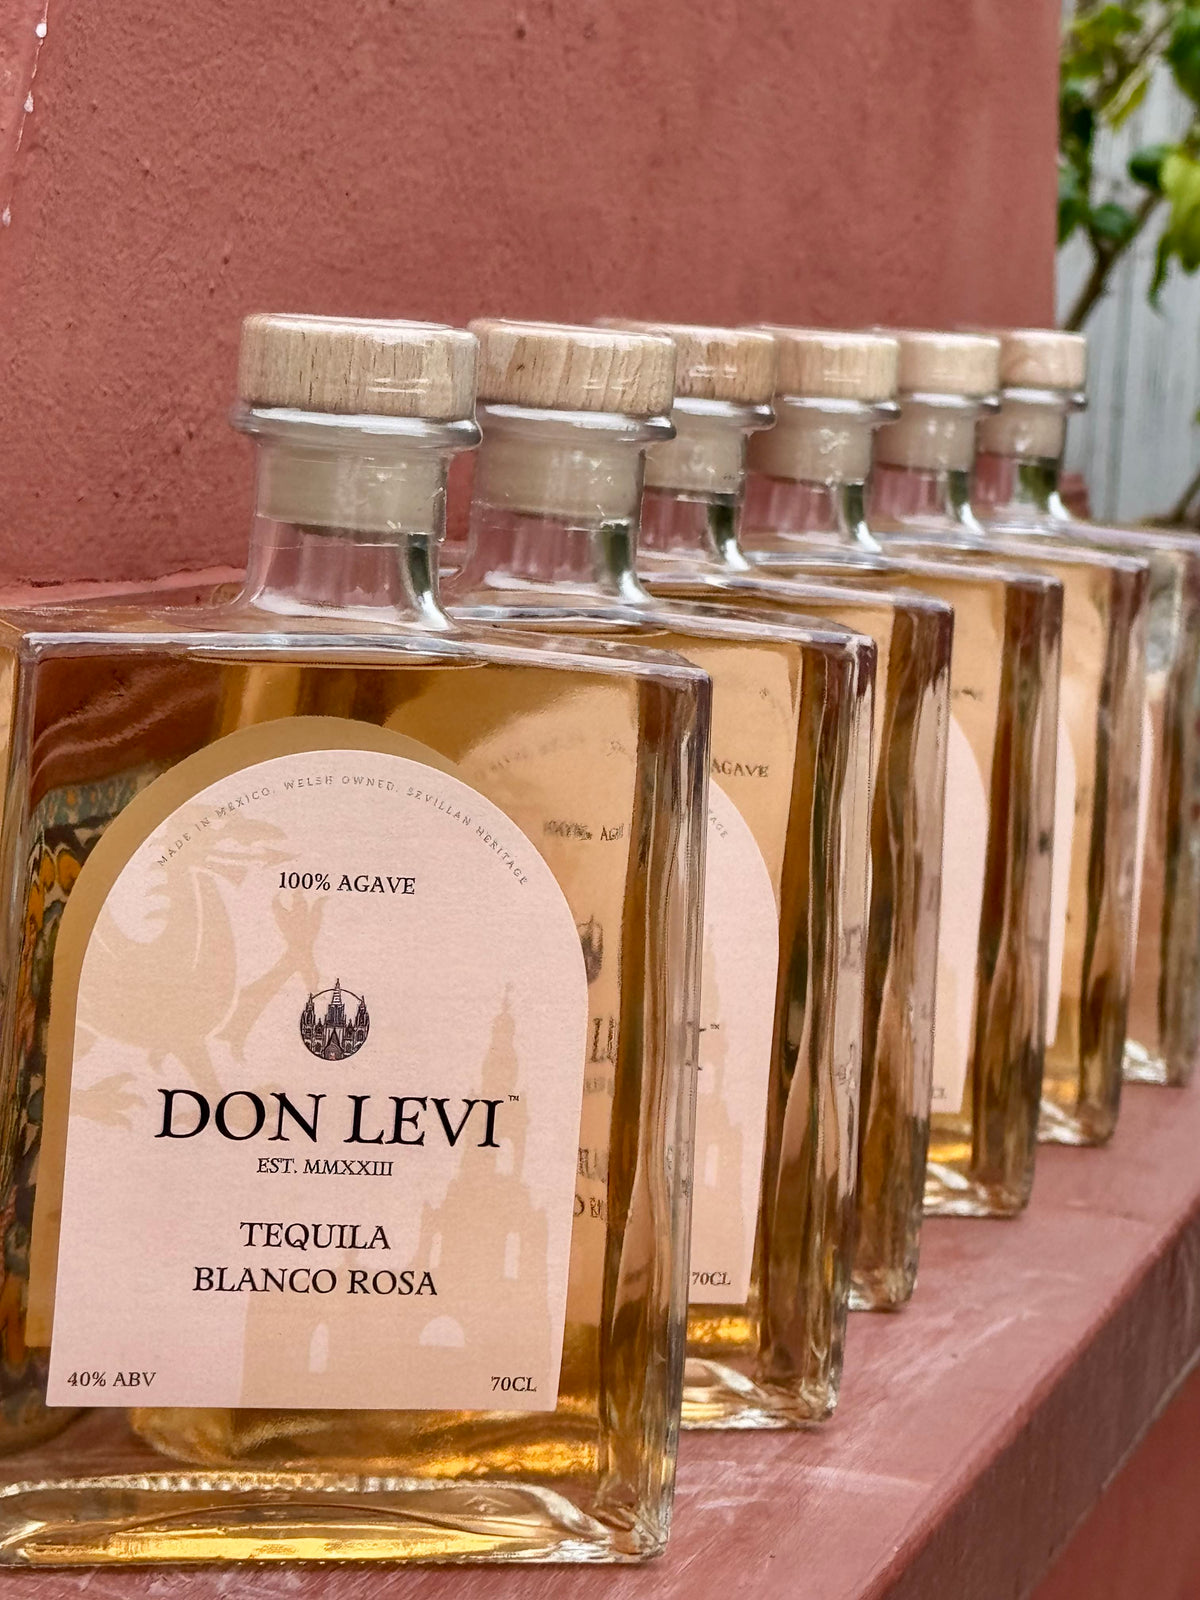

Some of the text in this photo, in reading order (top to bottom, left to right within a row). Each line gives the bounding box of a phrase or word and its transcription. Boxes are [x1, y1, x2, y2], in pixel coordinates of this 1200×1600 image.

[711, 759, 769, 778] AGAVE
[157, 832, 192, 867] MADE
[194, 816, 211, 832] IN
[283, 775, 333, 791] WELSH
[406, 787, 472, 827] SEVILLAN
[475, 825, 529, 886] HERITAGE
[279, 871, 416, 896] 100% AGAVE
[154, 1088, 328, 1144] DON
[343, 1094, 504, 1148] LEVI
[256, 1157, 394, 1177] EST. MMXXIII
[240, 1221, 391, 1251] TEQUILA
[192, 1266, 438, 1296] BLANCO ROSA
[692, 1271, 731, 1286] 70CL
[67, 1370, 157, 1388] 40% ABV
[491, 1375, 538, 1393] 70CL
